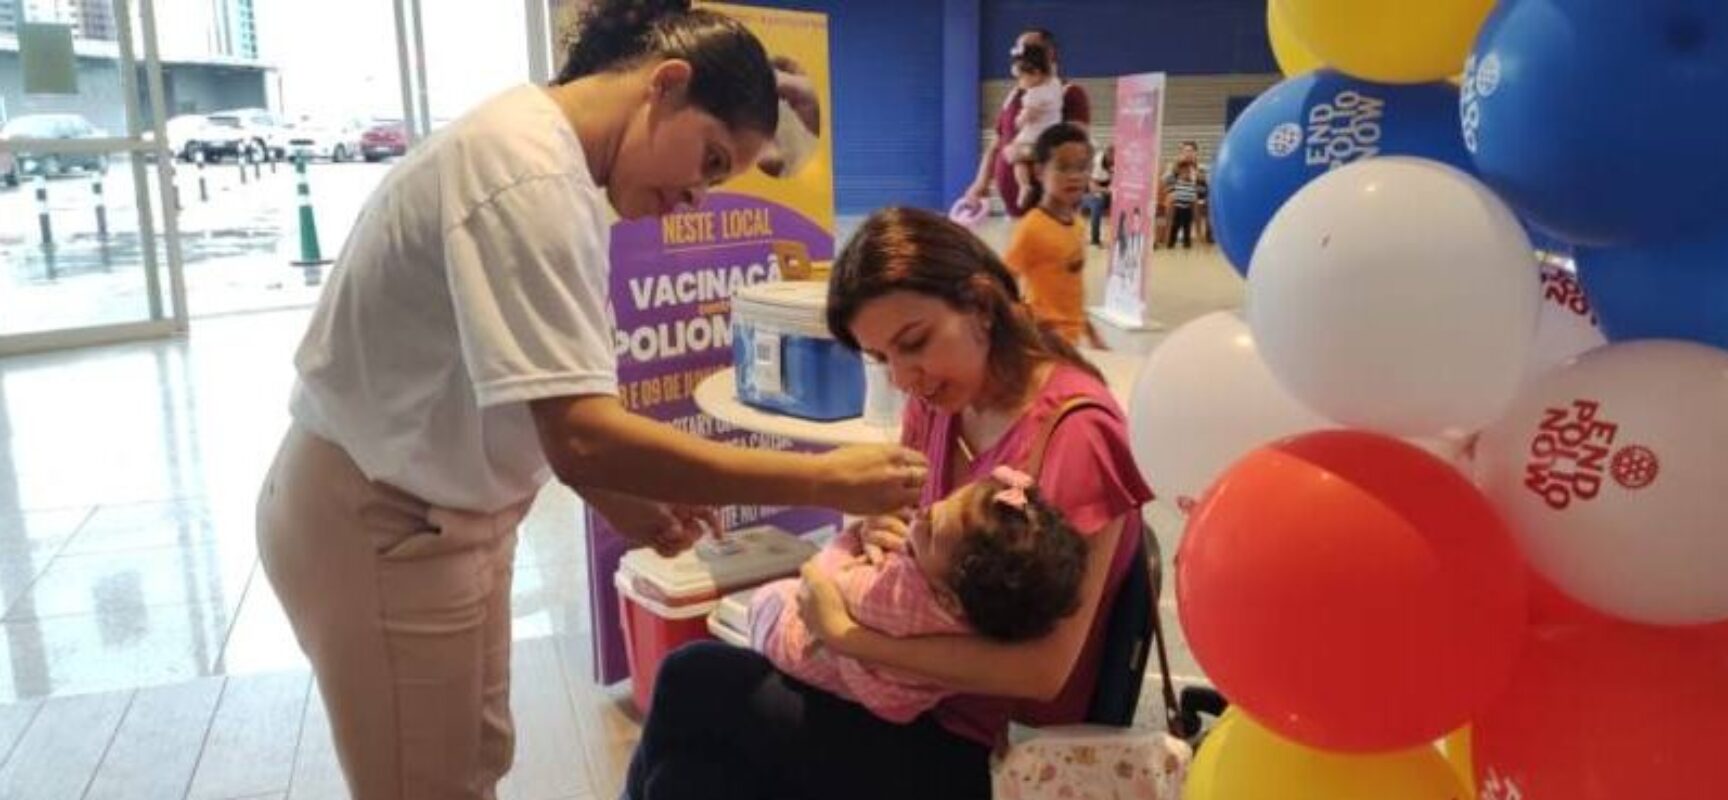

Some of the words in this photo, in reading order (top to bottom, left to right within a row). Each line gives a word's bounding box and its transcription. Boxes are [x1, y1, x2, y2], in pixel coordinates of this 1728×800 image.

[1306, 103, 1333, 165] END
[662, 212, 715, 244] NESTE
[722, 208, 773, 237] LOCAL
[1524, 408, 1568, 497] NOW
[1545, 399, 1599, 510] POLIO
[1571, 420, 1618, 500] END
